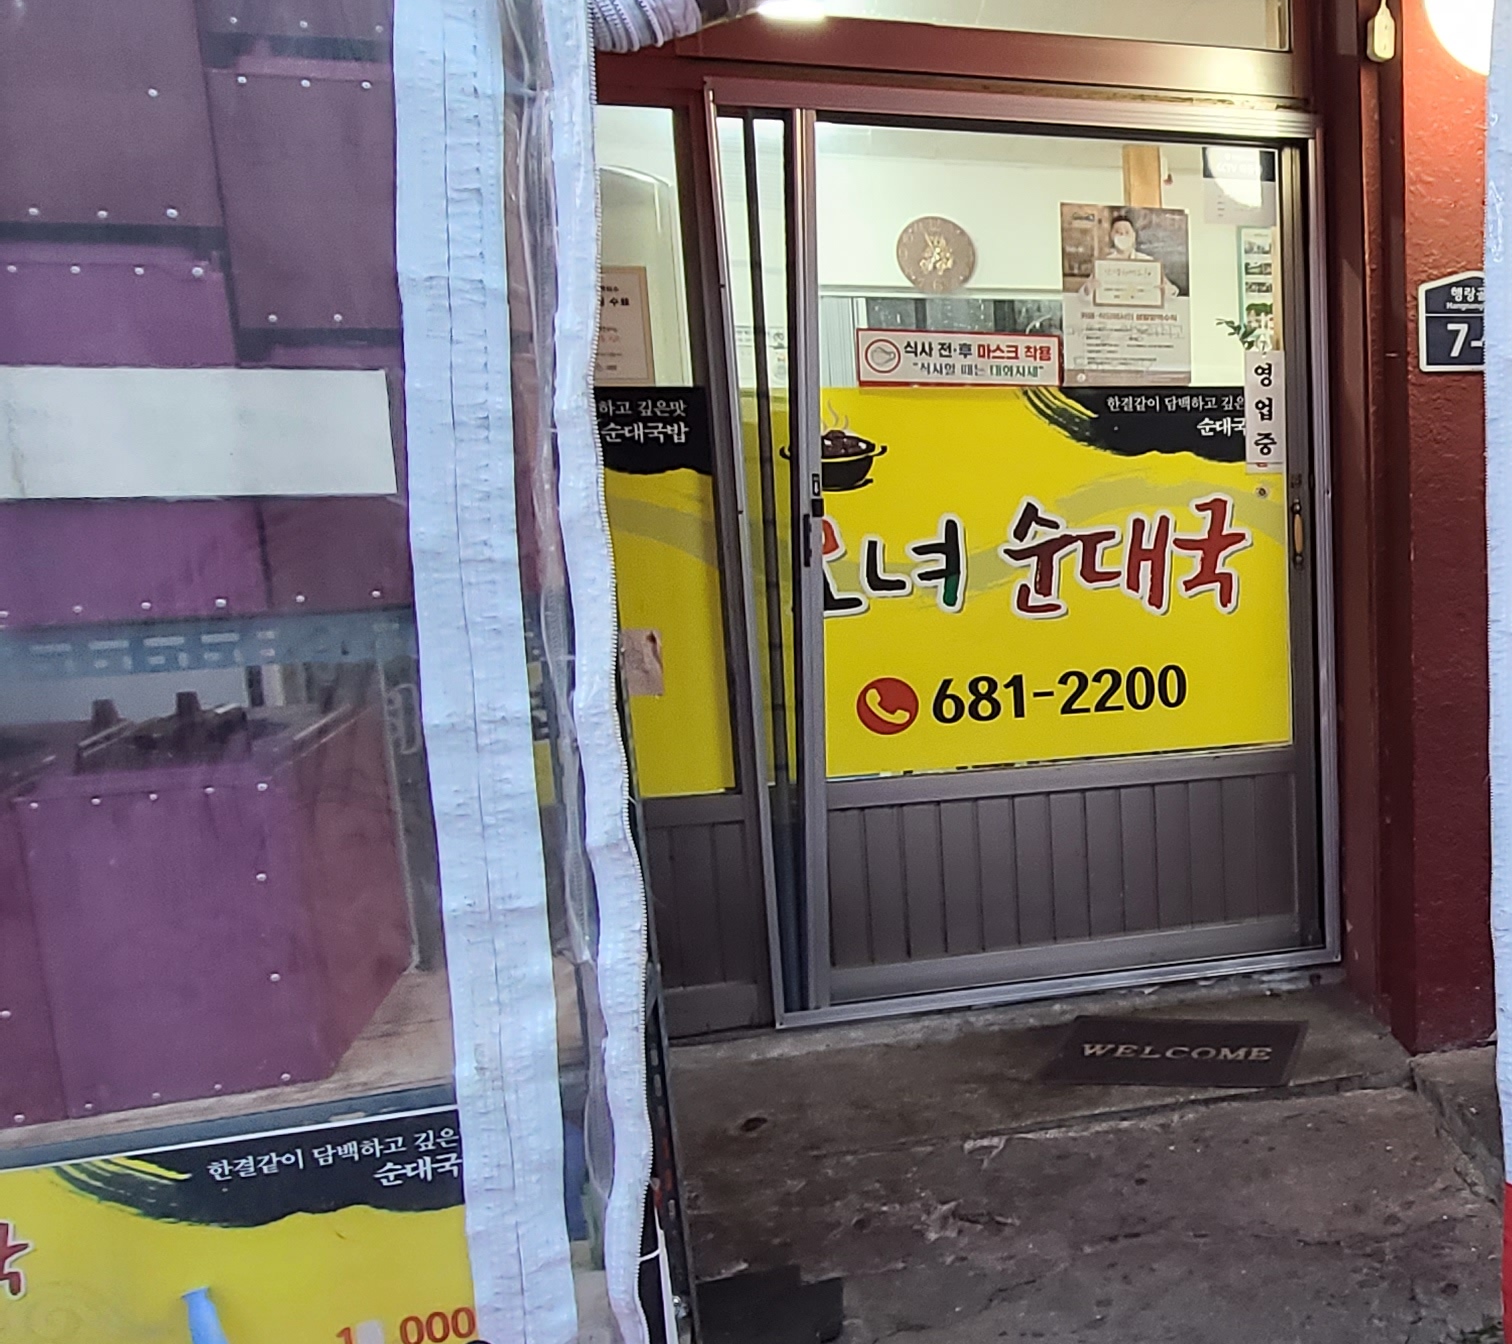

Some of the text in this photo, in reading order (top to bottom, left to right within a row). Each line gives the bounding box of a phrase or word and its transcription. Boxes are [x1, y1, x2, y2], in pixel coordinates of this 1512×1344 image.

[904, 341, 933, 358] 식사
[977, 343, 1020, 360] 마스크
[1024, 345, 1051, 362] 착용
[637, 399, 688, 417] 깊은맛
[1106, 395, 1160, 412] 한결같이
[1164, 395, 1218, 412] 담백하고
[601, 422, 690, 444] 순대국밥
[1003, 498, 1247, 611] 순대국
[932, 664, 1187, 724] 681-2200
[1082, 1043, 1272, 1060] WELCOME
[207, 1148, 304, 1182] 한결같이
[312, 1135, 407, 1167] 담백하고
